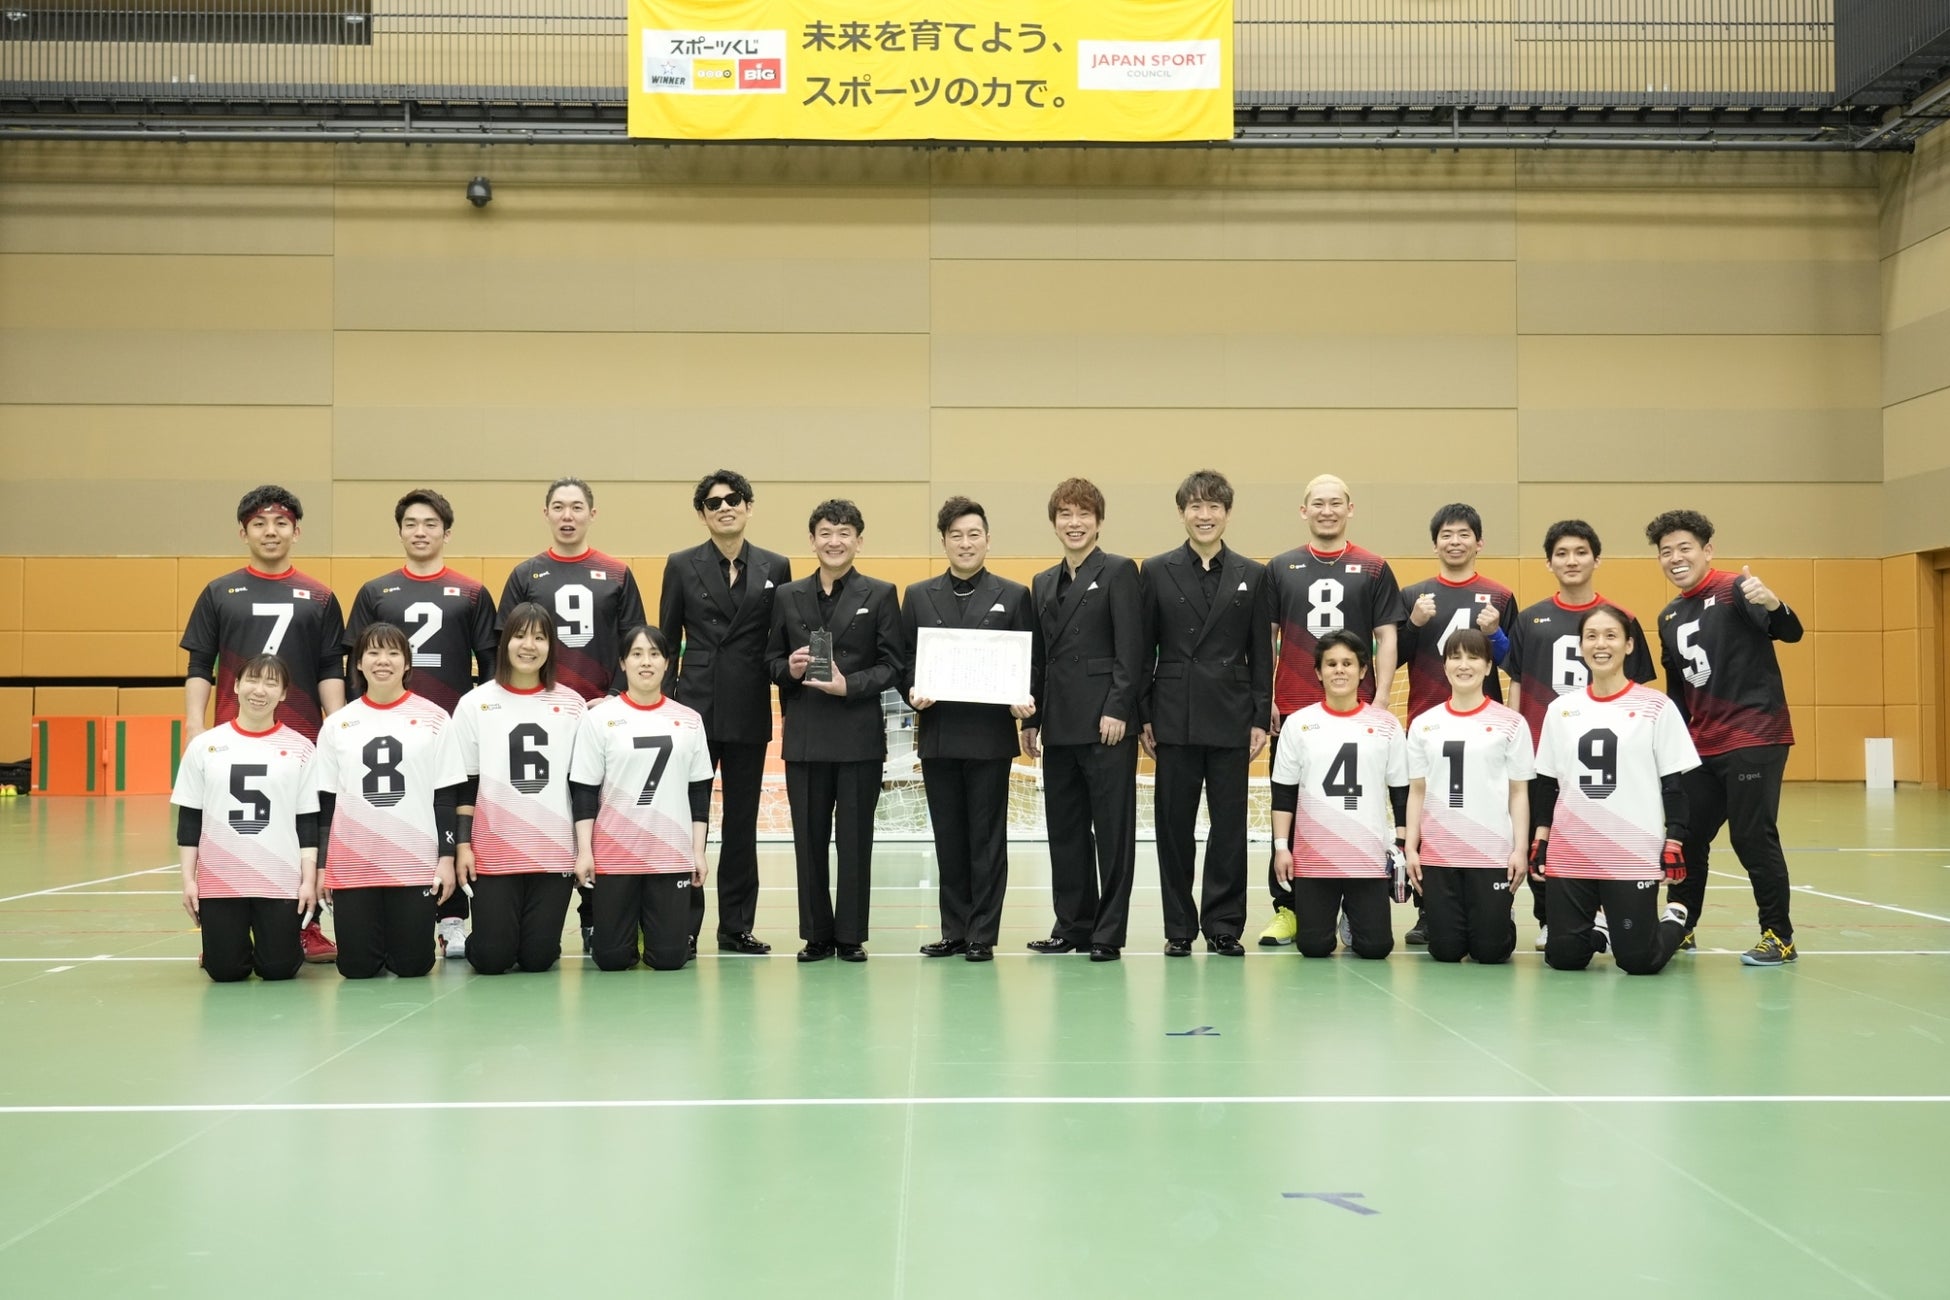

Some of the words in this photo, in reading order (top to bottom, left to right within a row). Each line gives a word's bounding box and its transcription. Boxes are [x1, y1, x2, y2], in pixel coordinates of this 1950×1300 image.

[670, 36, 759, 55] スポーツくじ
[802, 19, 1063, 53] 未来を育てよう、
[1091, 53, 1146, 68] JAPAN
[1151, 53, 1206, 67] SPORT
[651, 75, 686, 85] WINNER
[802, 74, 1065, 108] スポーツの力で。
[1127, 70, 1172, 78] COUNCIL
[252, 603, 294, 655] 7
[404, 602, 443, 667] 2
[555, 584, 594, 648] 9
[1307, 578, 1344, 640] 8
[1552, 635, 1590, 696] 6
[1677, 620, 1712, 688] 5
[362, 735, 405, 808] 8
[509, 723, 549, 794] 6
[633, 735, 674, 805] 7
[1322, 743, 1362, 810] 4
[1442, 741, 1465, 808] 1
[1578, 728, 1618, 799] 9
[228, 764, 271, 834] 5
